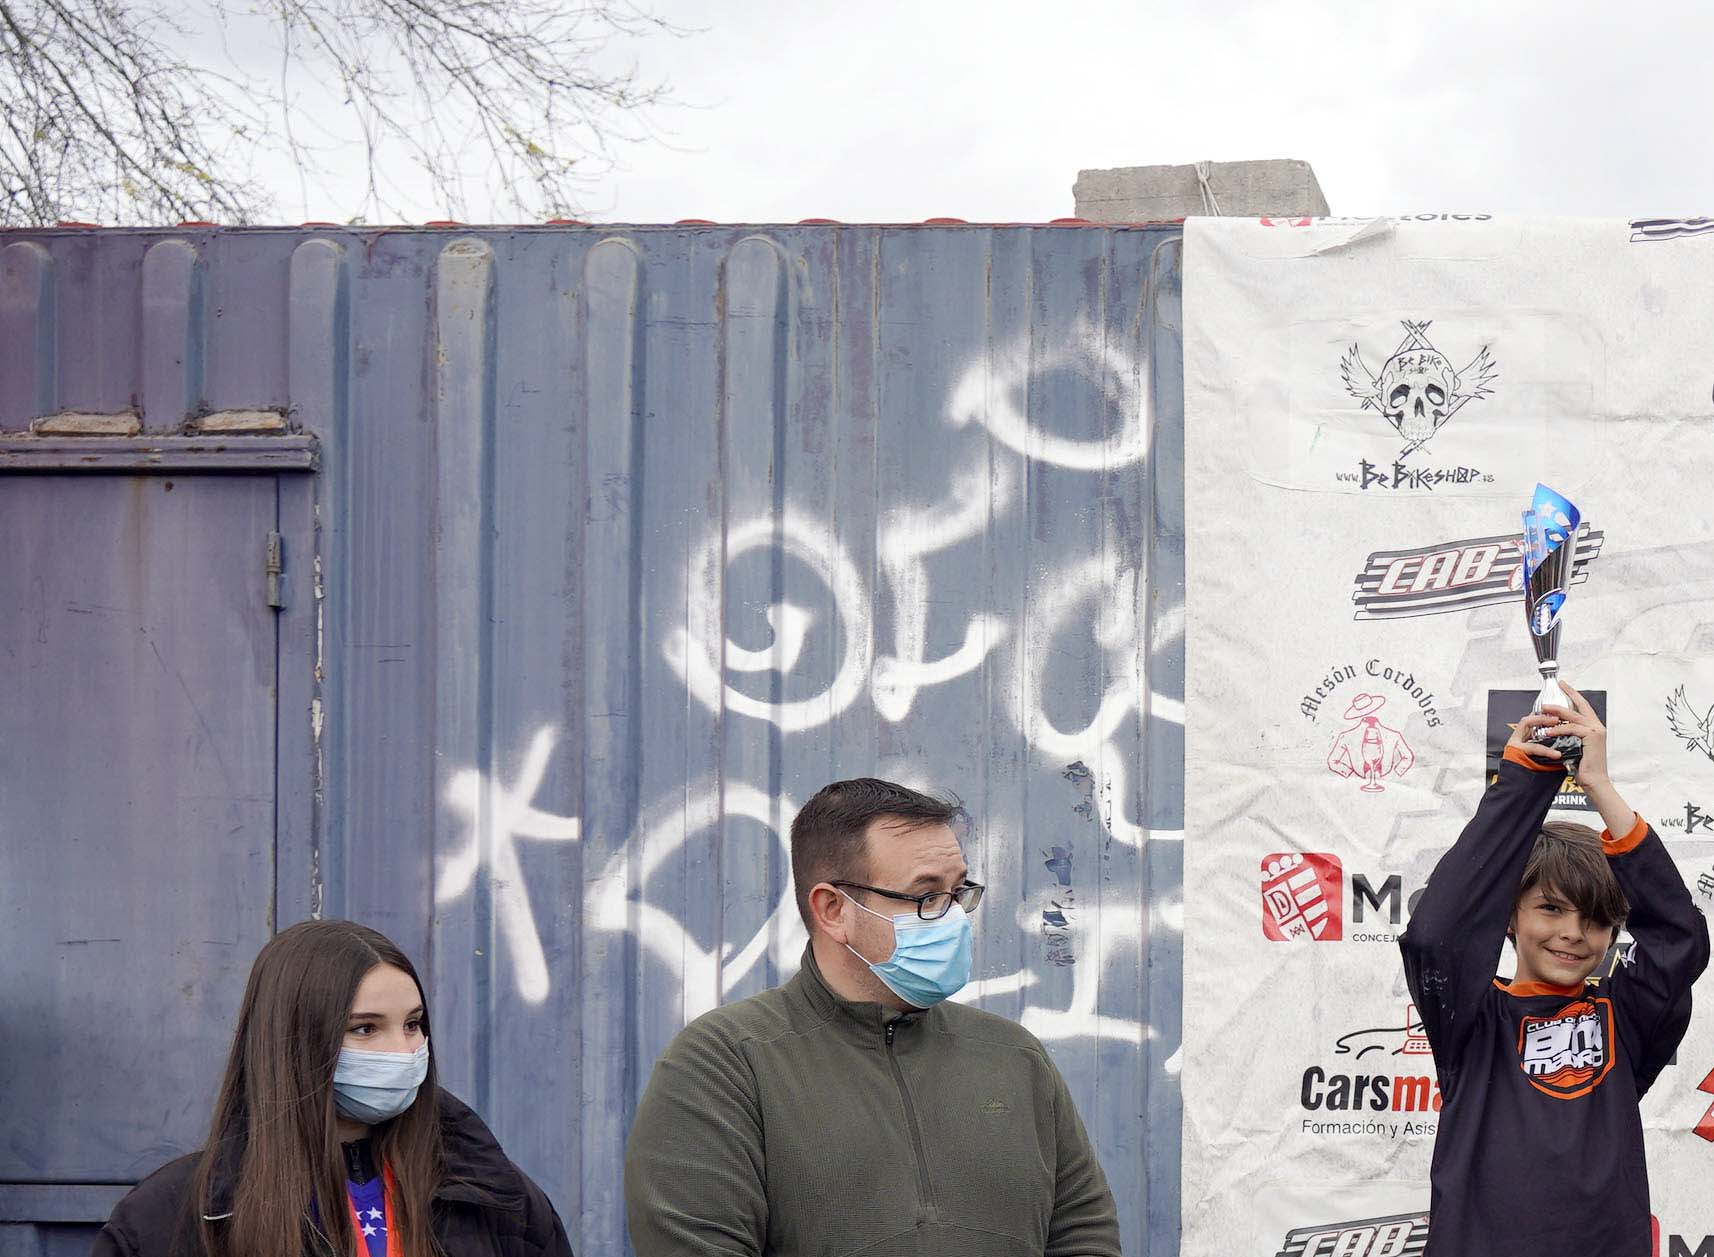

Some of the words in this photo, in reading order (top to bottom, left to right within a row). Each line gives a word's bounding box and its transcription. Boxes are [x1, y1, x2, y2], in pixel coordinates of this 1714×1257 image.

[1377, 544, 1502, 595] CAB
[1352, 932, 1401, 944] CONCEJ
[1300, 1065, 1444, 1111] Carsm
[1302, 1119, 1386, 1135] Formación
[1389, 1124, 1398, 1139] y
